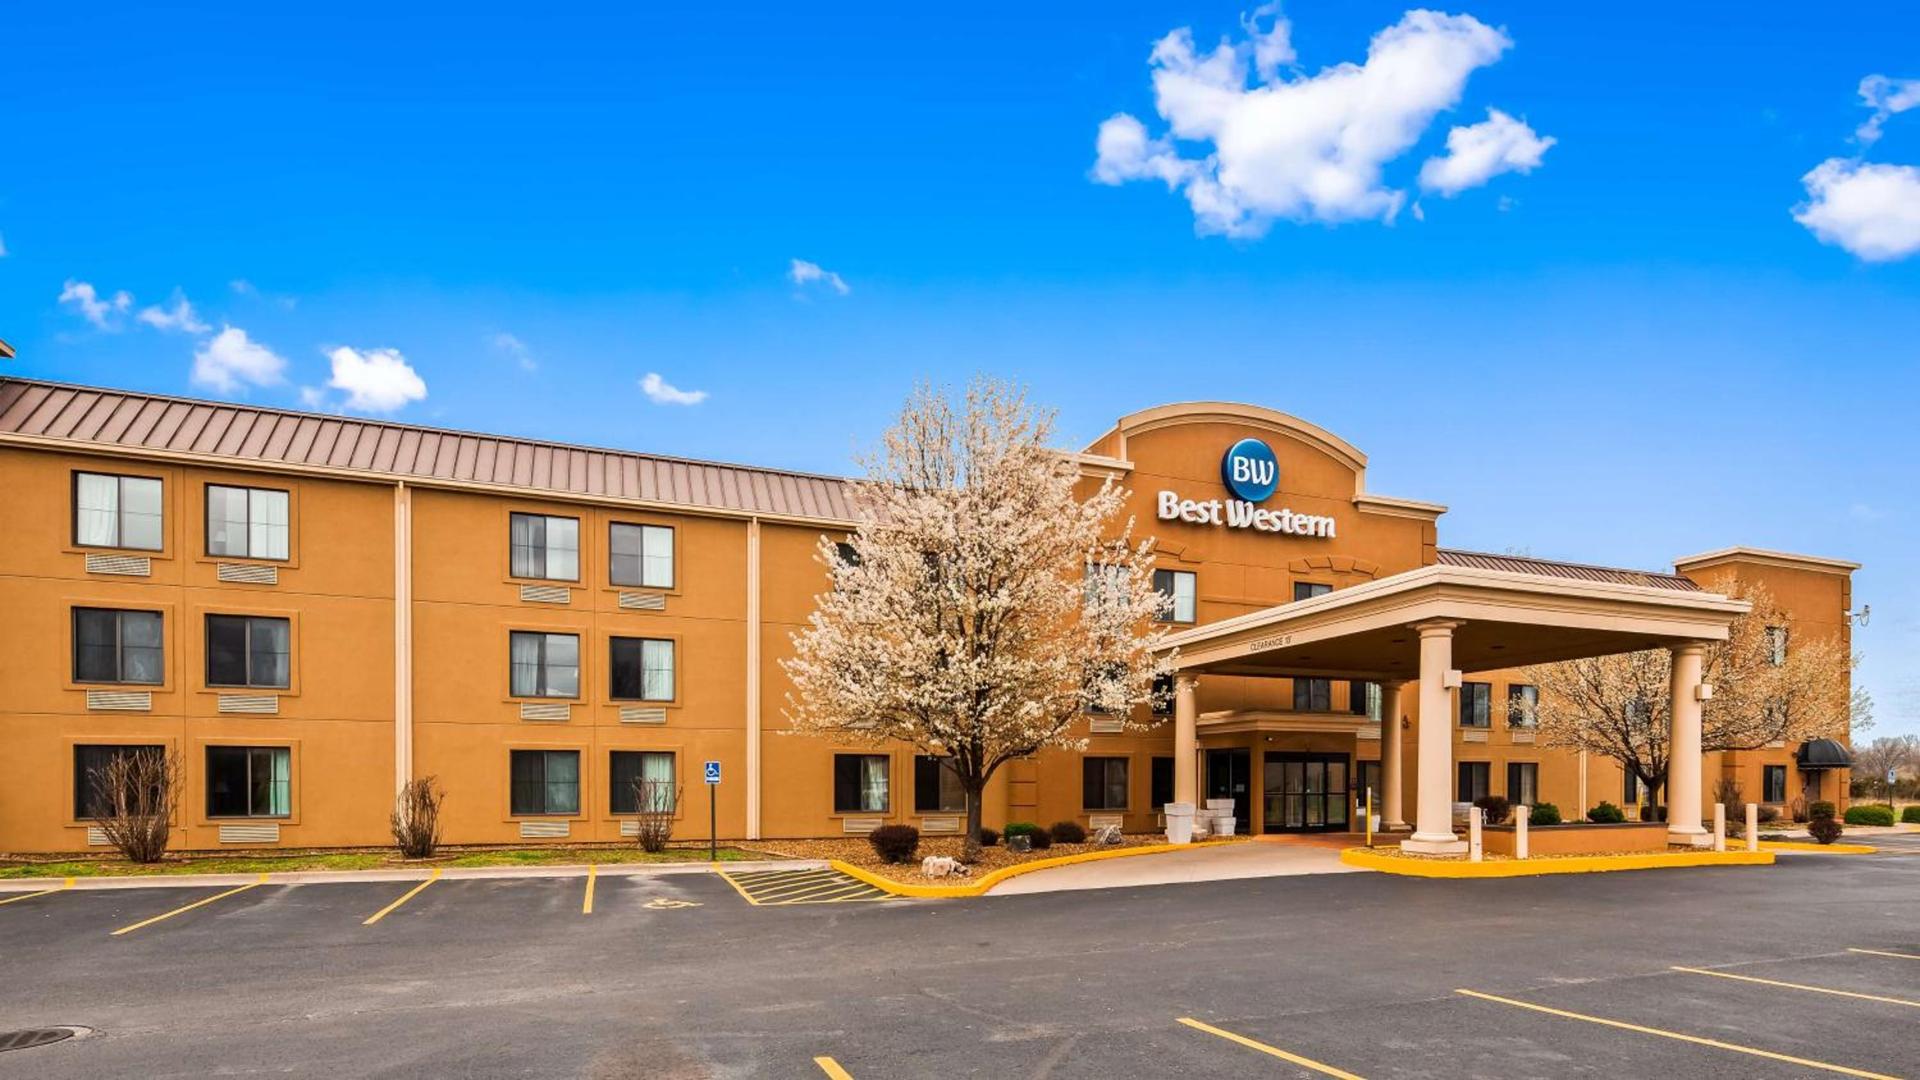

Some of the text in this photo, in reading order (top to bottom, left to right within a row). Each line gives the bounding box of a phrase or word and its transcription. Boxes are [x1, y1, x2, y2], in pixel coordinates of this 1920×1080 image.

[1233, 456, 1275, 486] BW
[1157, 490, 1336, 539] Best Western
[1250, 637, 1283, 650] CLEARANCE
